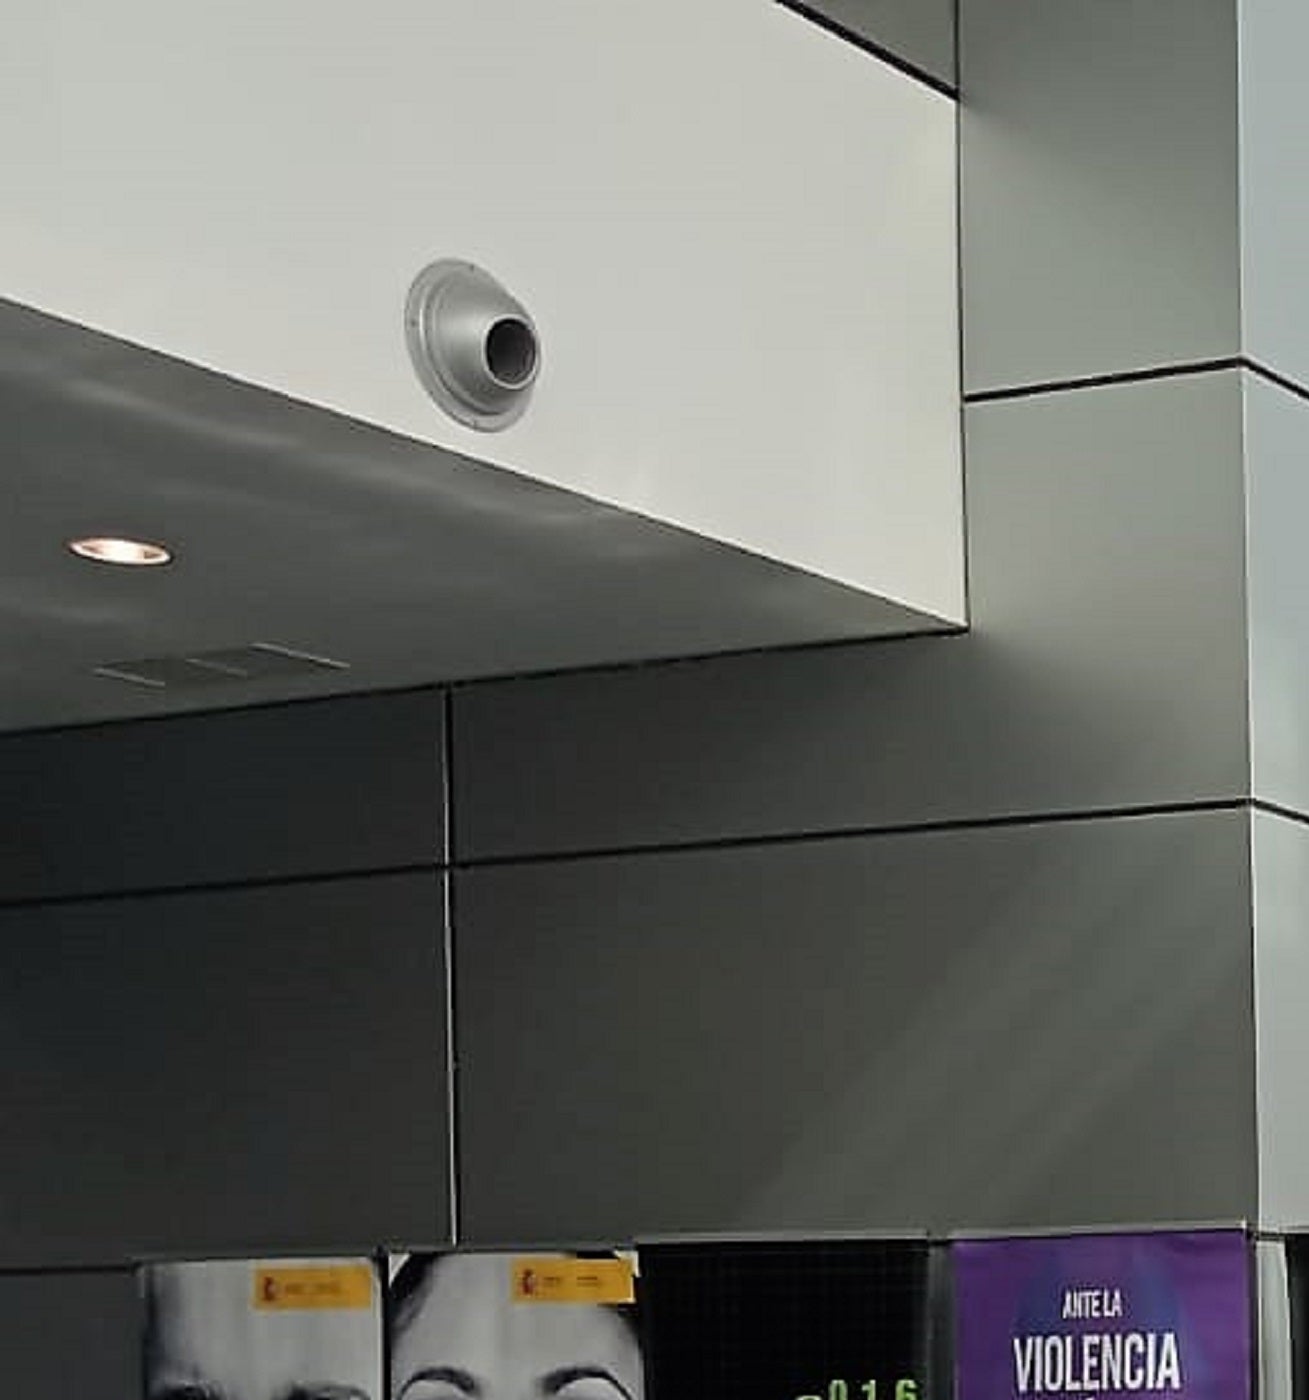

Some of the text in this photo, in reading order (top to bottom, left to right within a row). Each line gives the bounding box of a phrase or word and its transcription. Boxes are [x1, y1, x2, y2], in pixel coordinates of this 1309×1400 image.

[1062, 1289, 1123, 1319] ANTE LA
[1013, 1333, 1181, 1393] VIOLENCIA
